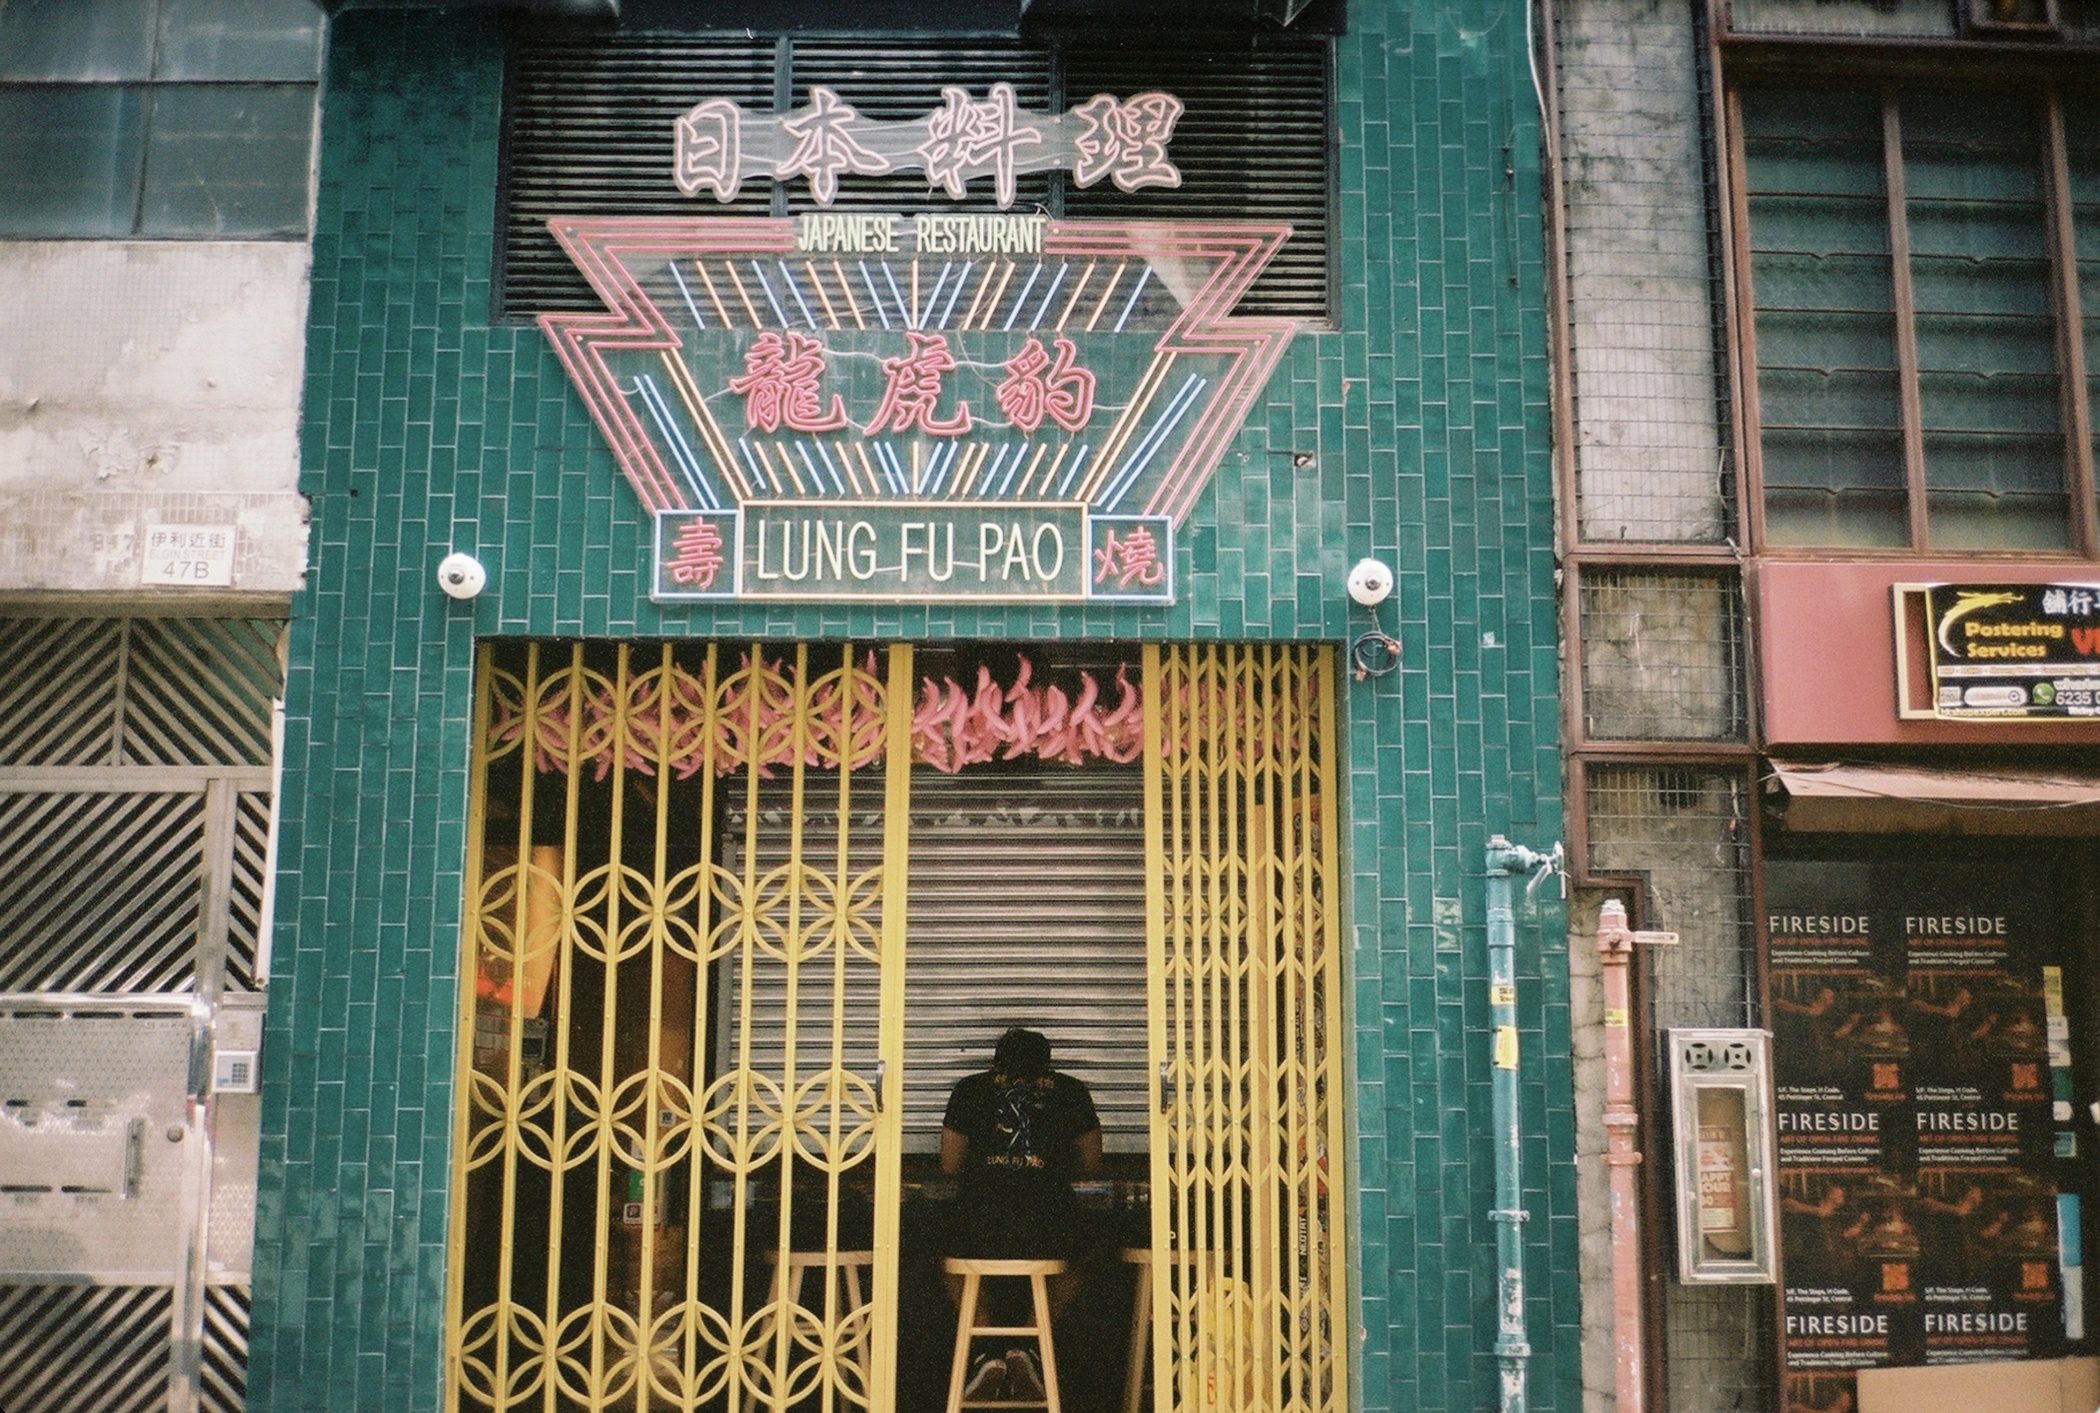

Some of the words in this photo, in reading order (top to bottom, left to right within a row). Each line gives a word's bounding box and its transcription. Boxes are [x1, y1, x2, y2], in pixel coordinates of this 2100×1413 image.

[674, 82, 1184, 209] 日本料理
[799, 215, 900, 253] JAPANESE
[916, 215, 1046, 254] RESTAURANT
[730, 330, 1096, 437] 龍虎豹
[151, 532, 226, 549] 伊利近街
[757, 519, 877, 581] LUNG
[901, 522, 954, 583] FU
[978, 522, 1064, 583] PAO
[1095, 526, 1164, 589] 燒
[163, 561, 210, 579] 47B
[1964, 621, 2064, 639] Postering
[1967, 643, 2047, 657] Services
[2055, 691, 2092, 705] 6235
[1769, 916, 1870, 933] FIRESIDE
[1905, 917, 2008, 934] FIRESIDE
[1778, 1113, 1880, 1131] FIRESIDE
[1916, 1112, 2018, 1130] FIRESIDE
[1701, 1172, 1731, 1181] APPY
[1702, 1181, 1731, 1192] OUR
[1786, 1315, 1888, 1334] FIRESIDE
[1924, 1313, 2028, 1332] FIRESIDE
